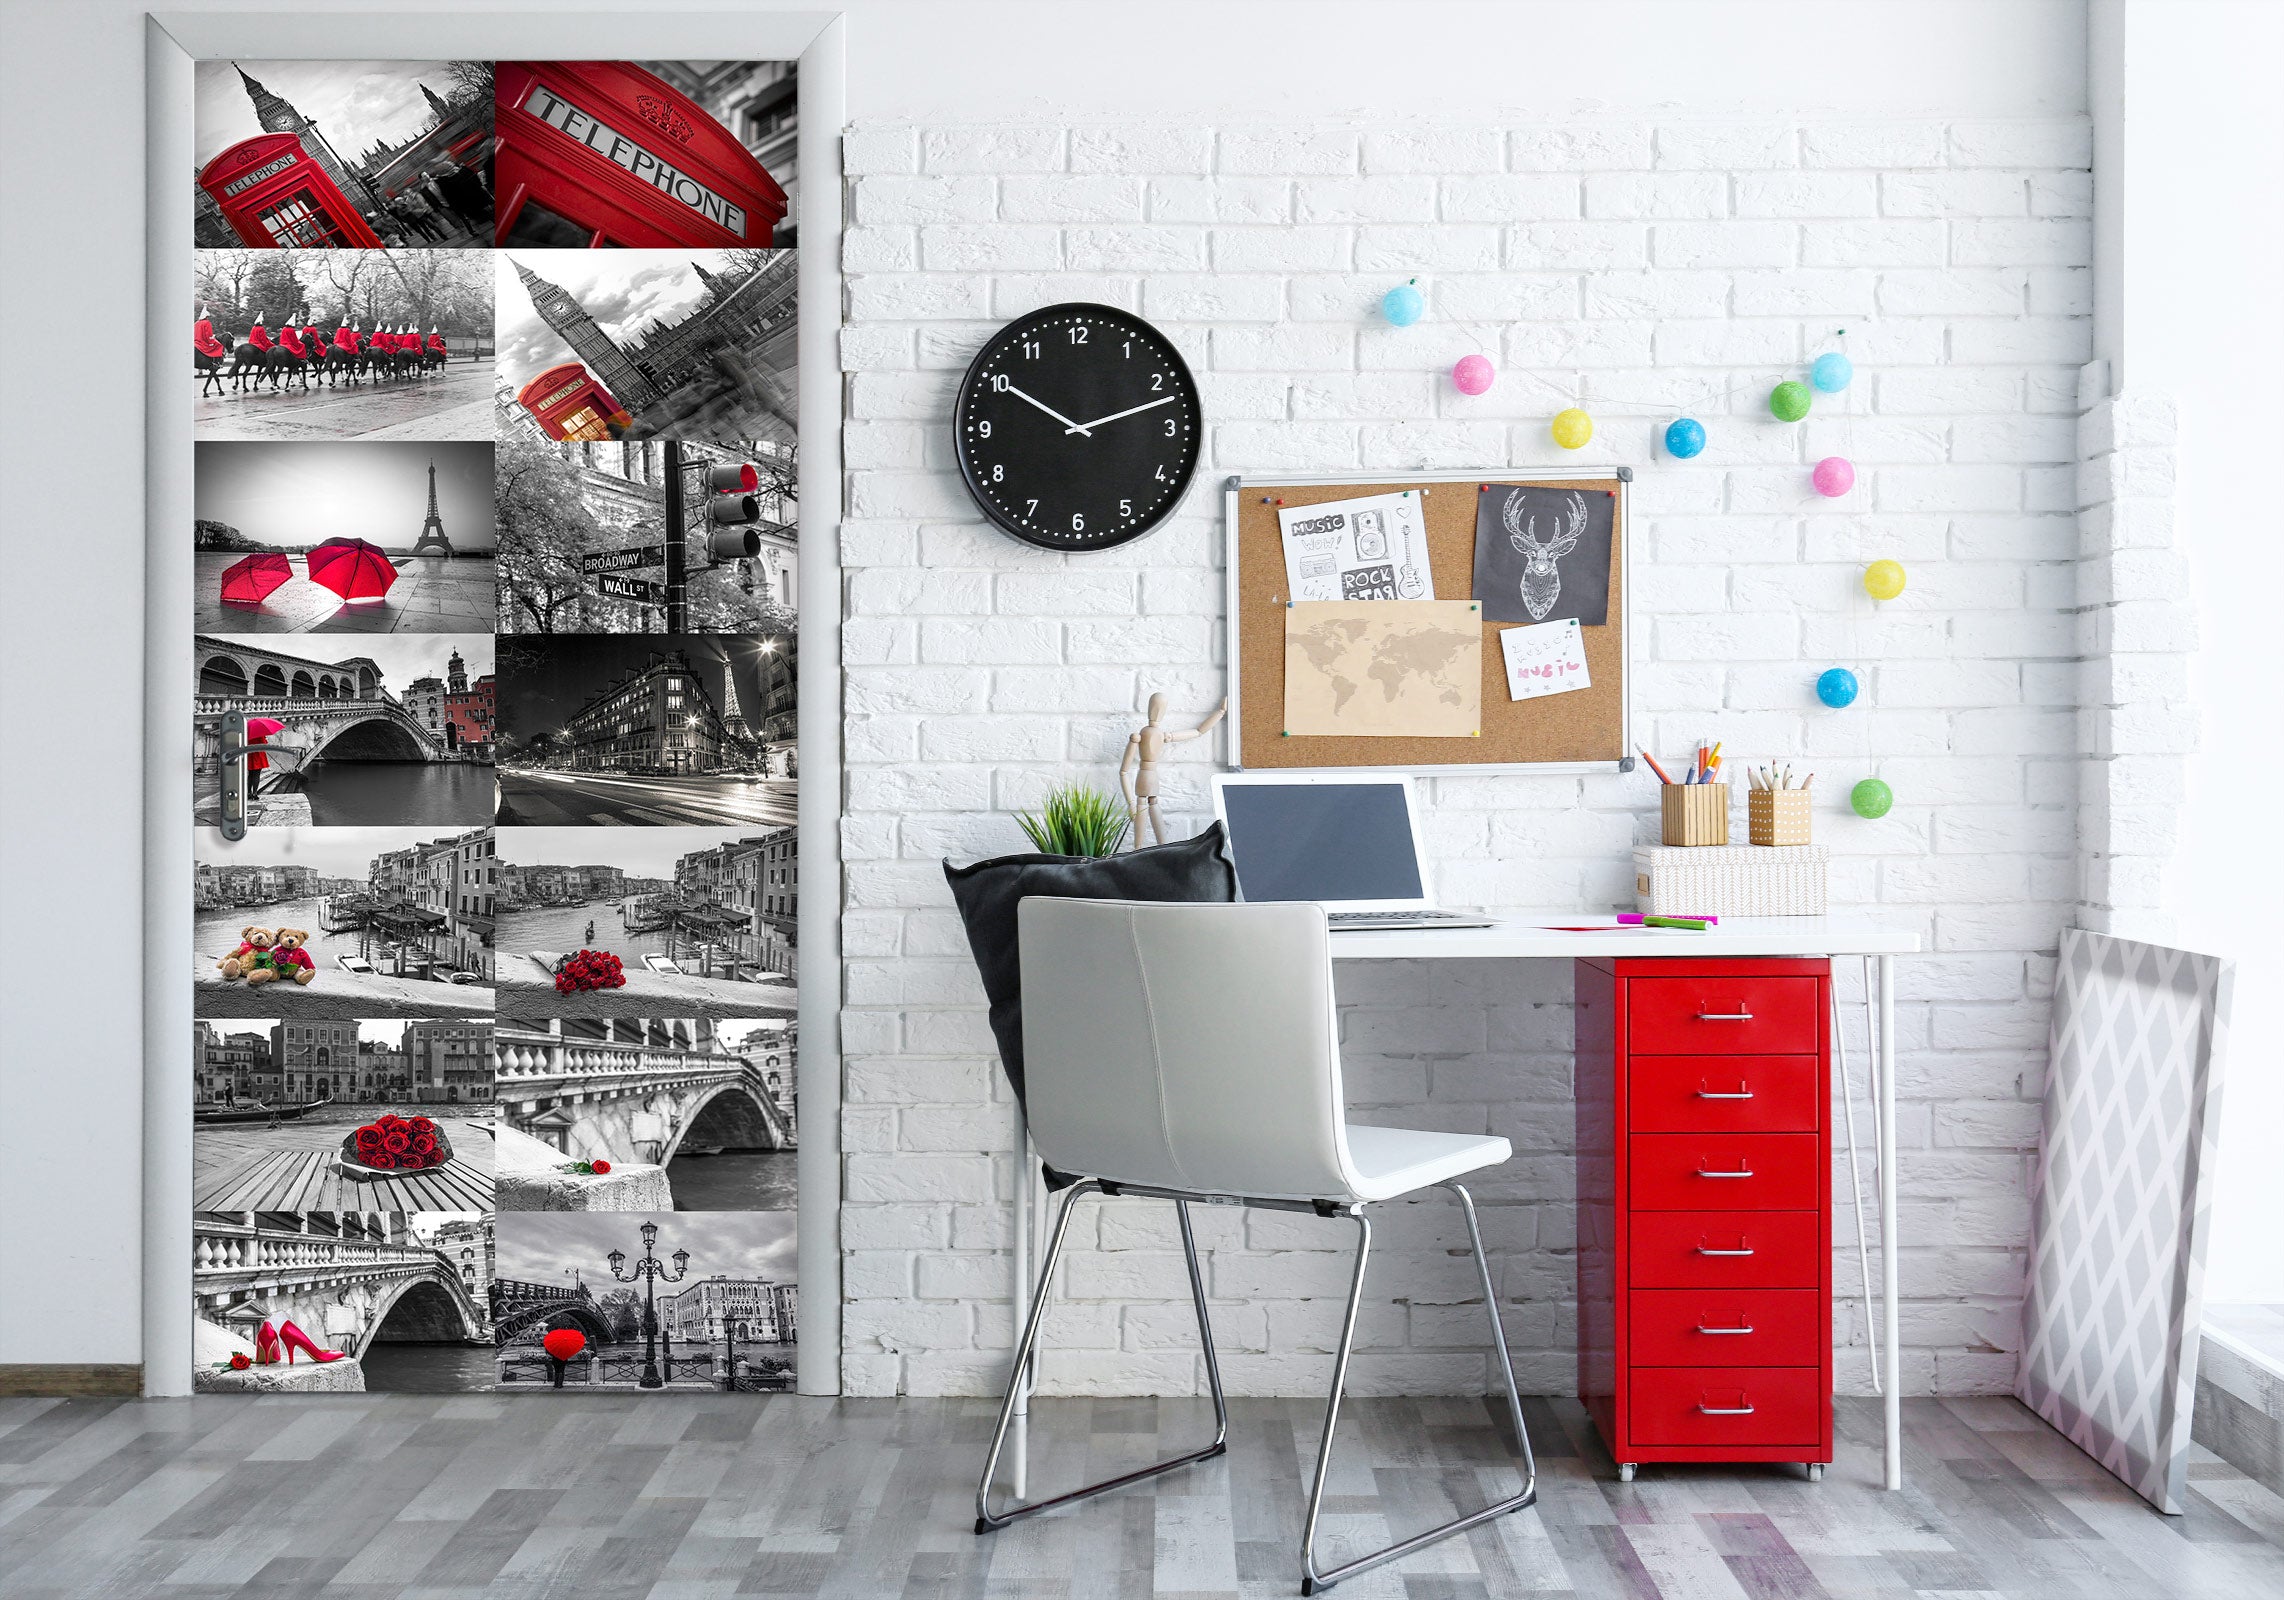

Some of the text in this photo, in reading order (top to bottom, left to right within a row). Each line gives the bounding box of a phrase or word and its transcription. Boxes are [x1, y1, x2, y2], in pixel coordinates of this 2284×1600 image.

[539, 92, 741, 235] TELEPHONE
[225, 154, 296, 195] TELEPHONE
[1068, 326, 1088, 344] 12
[1023, 342, 1040, 360] 11
[1122, 342, 1130, 359] 1
[990, 374, 1009, 393] 10
[1151, 373, 1163, 391] 2
[979, 420, 992, 438] 9
[1164, 419, 1176, 437] 3
[992, 464, 1004, 483] 8
[1155, 465, 1166, 482] 4
[1026, 499, 1039, 517] 7
[1119, 499, 1132, 517] 5
[1072, 513, 1085, 531] 6
[584, 552, 640, 571] BROADWAY
[1344, 567, 1392, 589] ROCK
[604, 579, 645, 597] WALL ST
